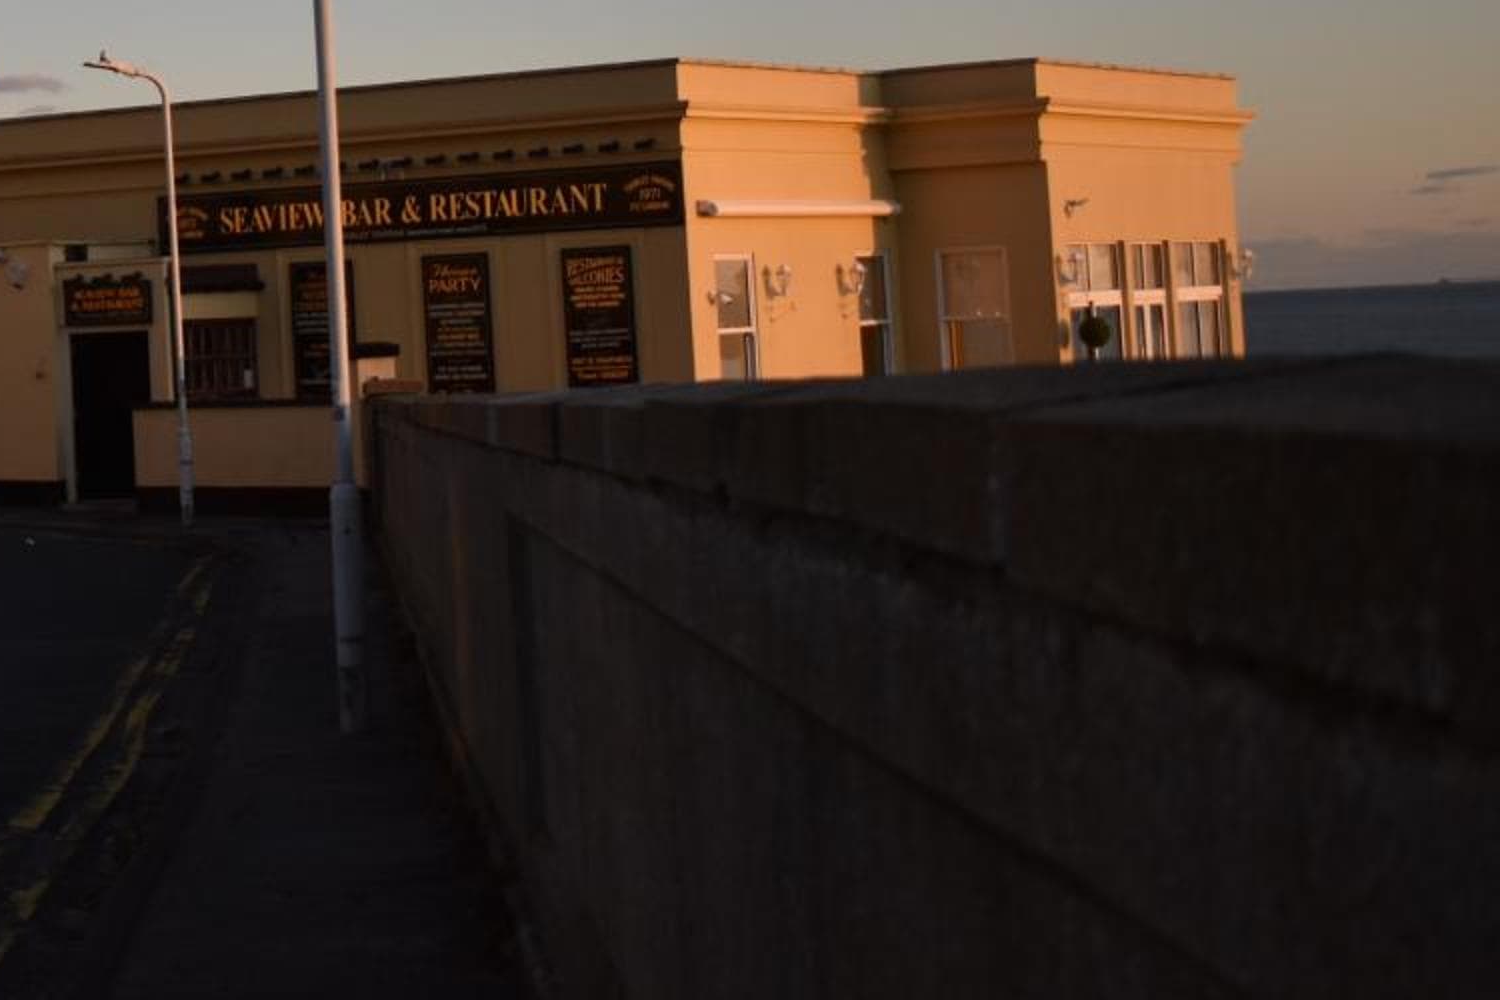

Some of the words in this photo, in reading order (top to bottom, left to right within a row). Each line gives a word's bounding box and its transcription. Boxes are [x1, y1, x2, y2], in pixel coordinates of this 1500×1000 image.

[220, 202, 327, 233] SEAVIEW
[340, 198, 391, 227] BAR
[401, 195, 421, 223] &
[430, 183, 608, 221] RESTAURANT
[428, 276, 481, 293] PARTY
